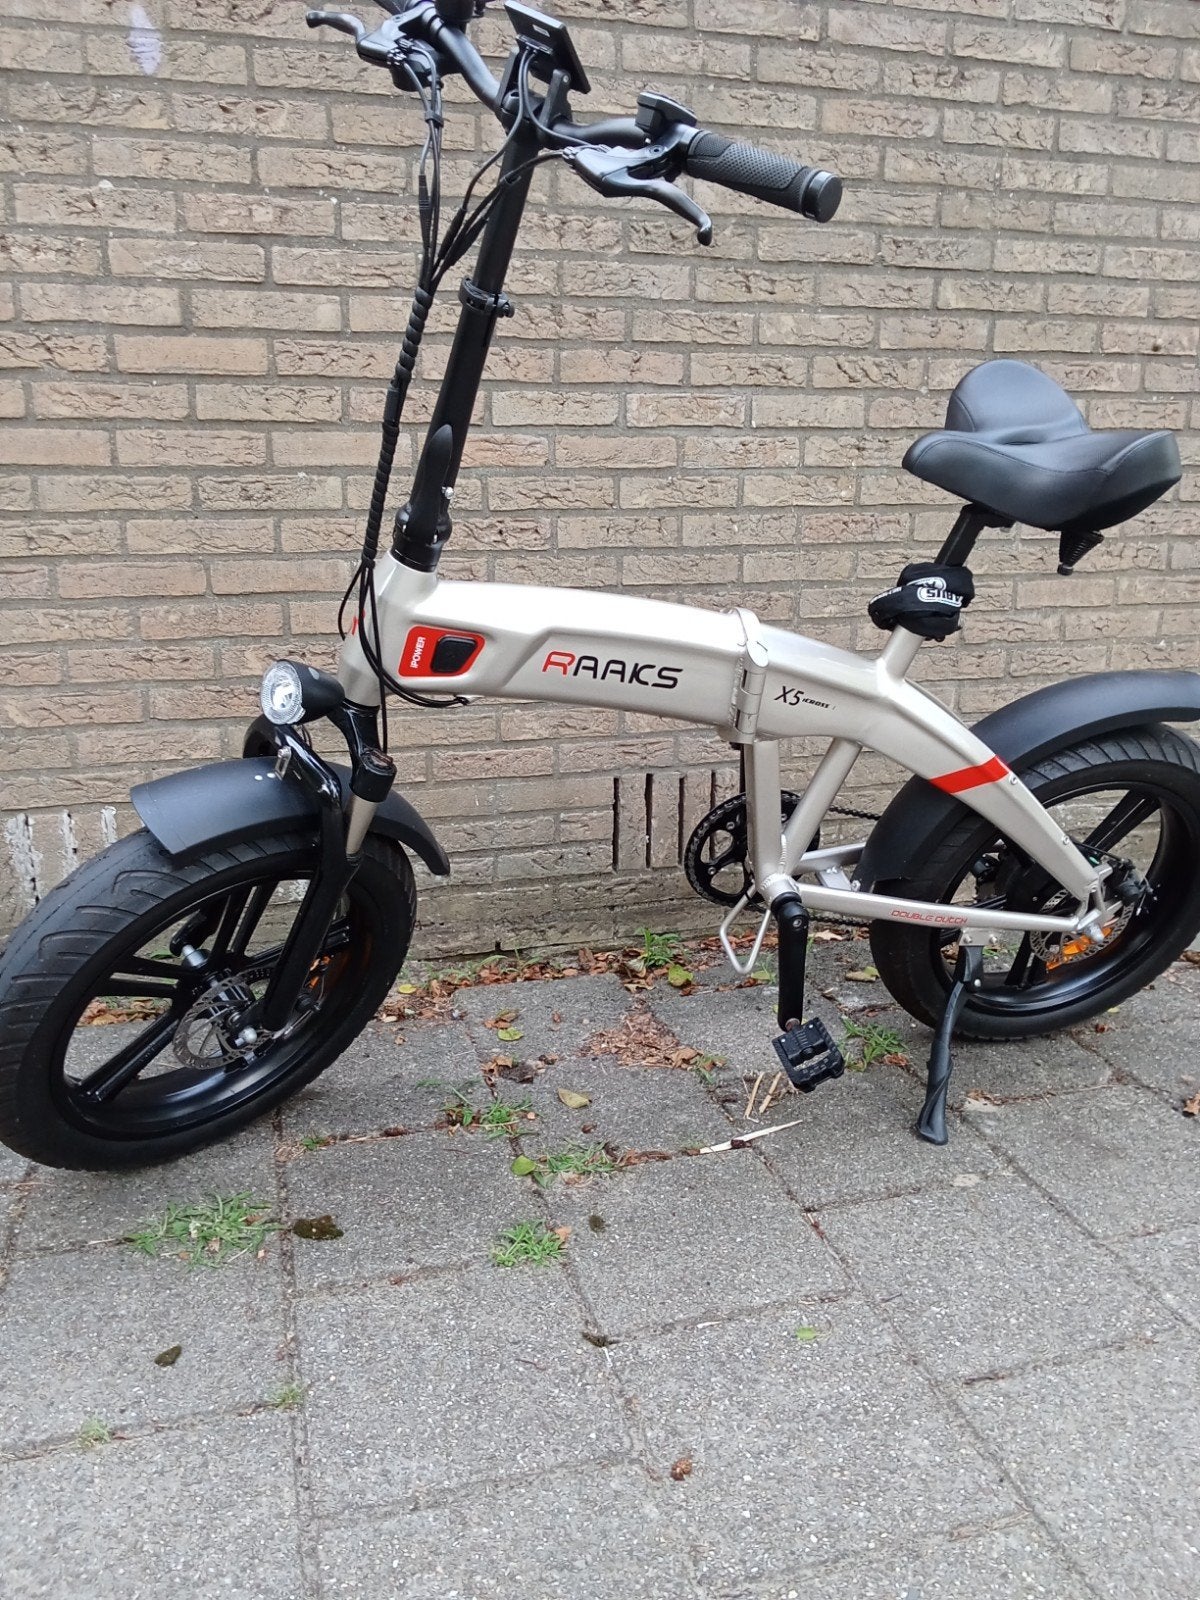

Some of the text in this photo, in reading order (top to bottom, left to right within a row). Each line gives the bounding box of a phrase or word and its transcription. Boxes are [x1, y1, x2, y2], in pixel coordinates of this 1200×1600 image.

[542, 651, 684, 689] RAAKS
[774, 686, 804, 706] X5
[891, 910, 934, 922] DOUBLE
